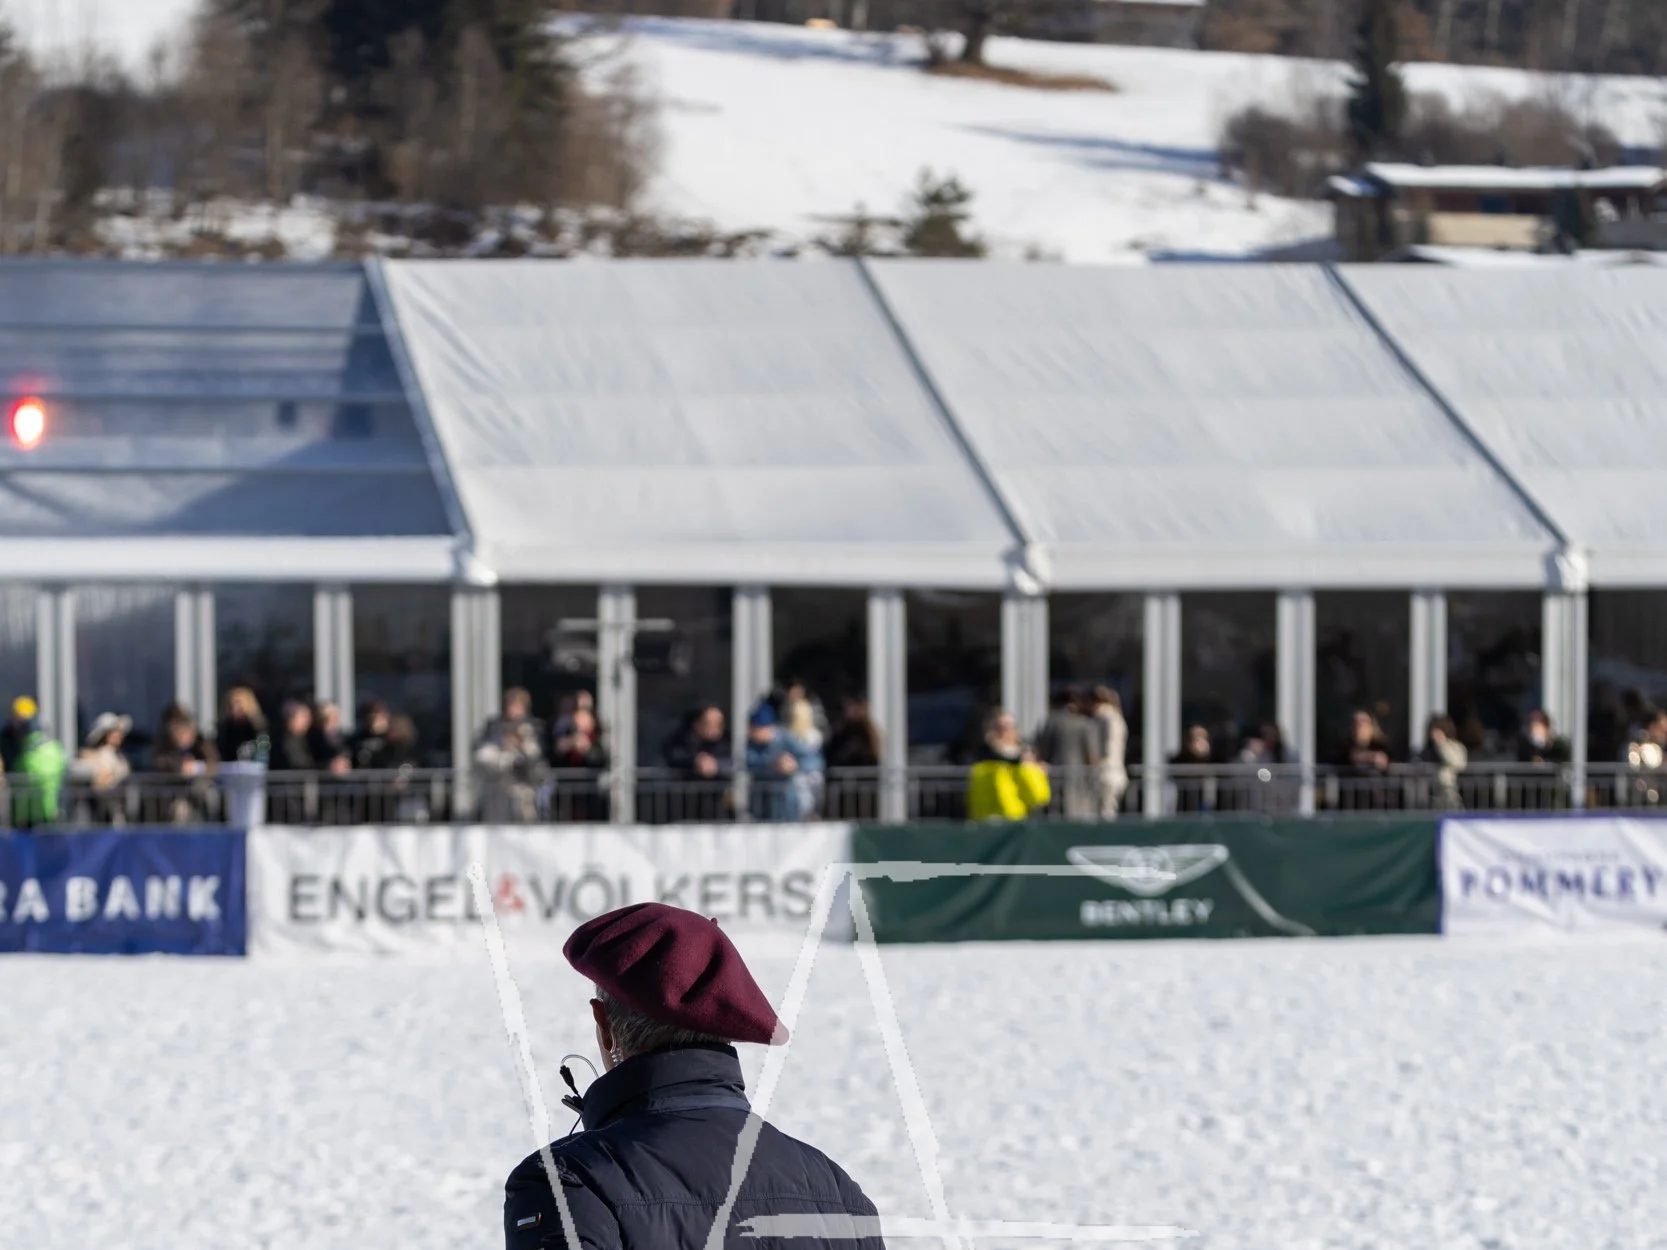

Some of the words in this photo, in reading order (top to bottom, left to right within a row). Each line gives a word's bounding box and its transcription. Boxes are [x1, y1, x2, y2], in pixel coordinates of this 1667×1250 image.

[65, 874, 222, 923] BANK
[1459, 865, 1664, 901] POMMERY
[1079, 898, 1214, 927] BENTLEY
